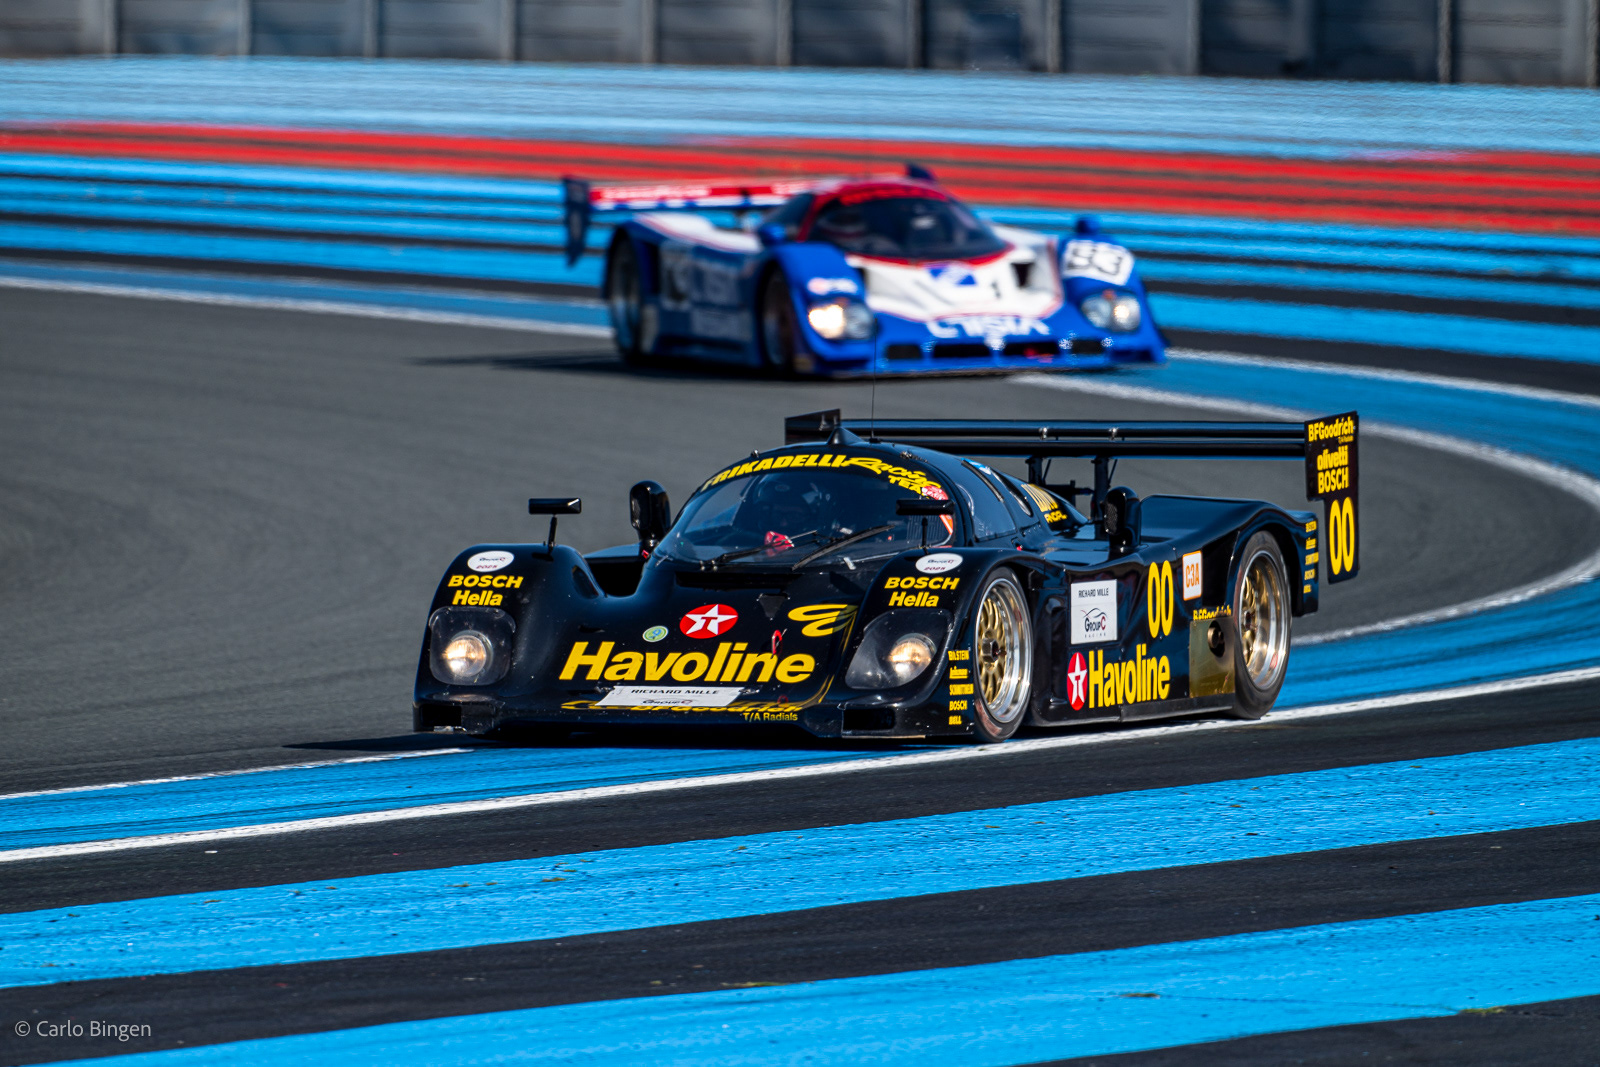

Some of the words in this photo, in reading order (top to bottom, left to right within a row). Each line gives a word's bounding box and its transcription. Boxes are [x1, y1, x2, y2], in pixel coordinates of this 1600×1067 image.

[1308, 416, 1354, 442] BFGoodrich
[1317, 444, 1348, 471] olivetti
[701, 454, 850, 492] FRIKADELLI
[888, 474, 927, 496] TEA
[1318, 466, 1349, 494] BOSCH
[1329, 497, 1355, 575] 00
[448, 575, 523, 588] BOSCH
[885, 577, 959, 589] BOSCH
[1185, 563, 1200, 588] C3A
[452, 590, 503, 606] Hella
[889, 592, 939, 607] Hella
[1078, 589, 1096, 598] RICHARD
[1148, 561, 1174, 638] 00
[559, 641, 815, 684] Havoline
[1089, 644, 1170, 708] Havoline
[743, 712, 760, 721] T/A
[763, 712, 798, 721] Radials
[949, 700, 967, 711] BOSCH
